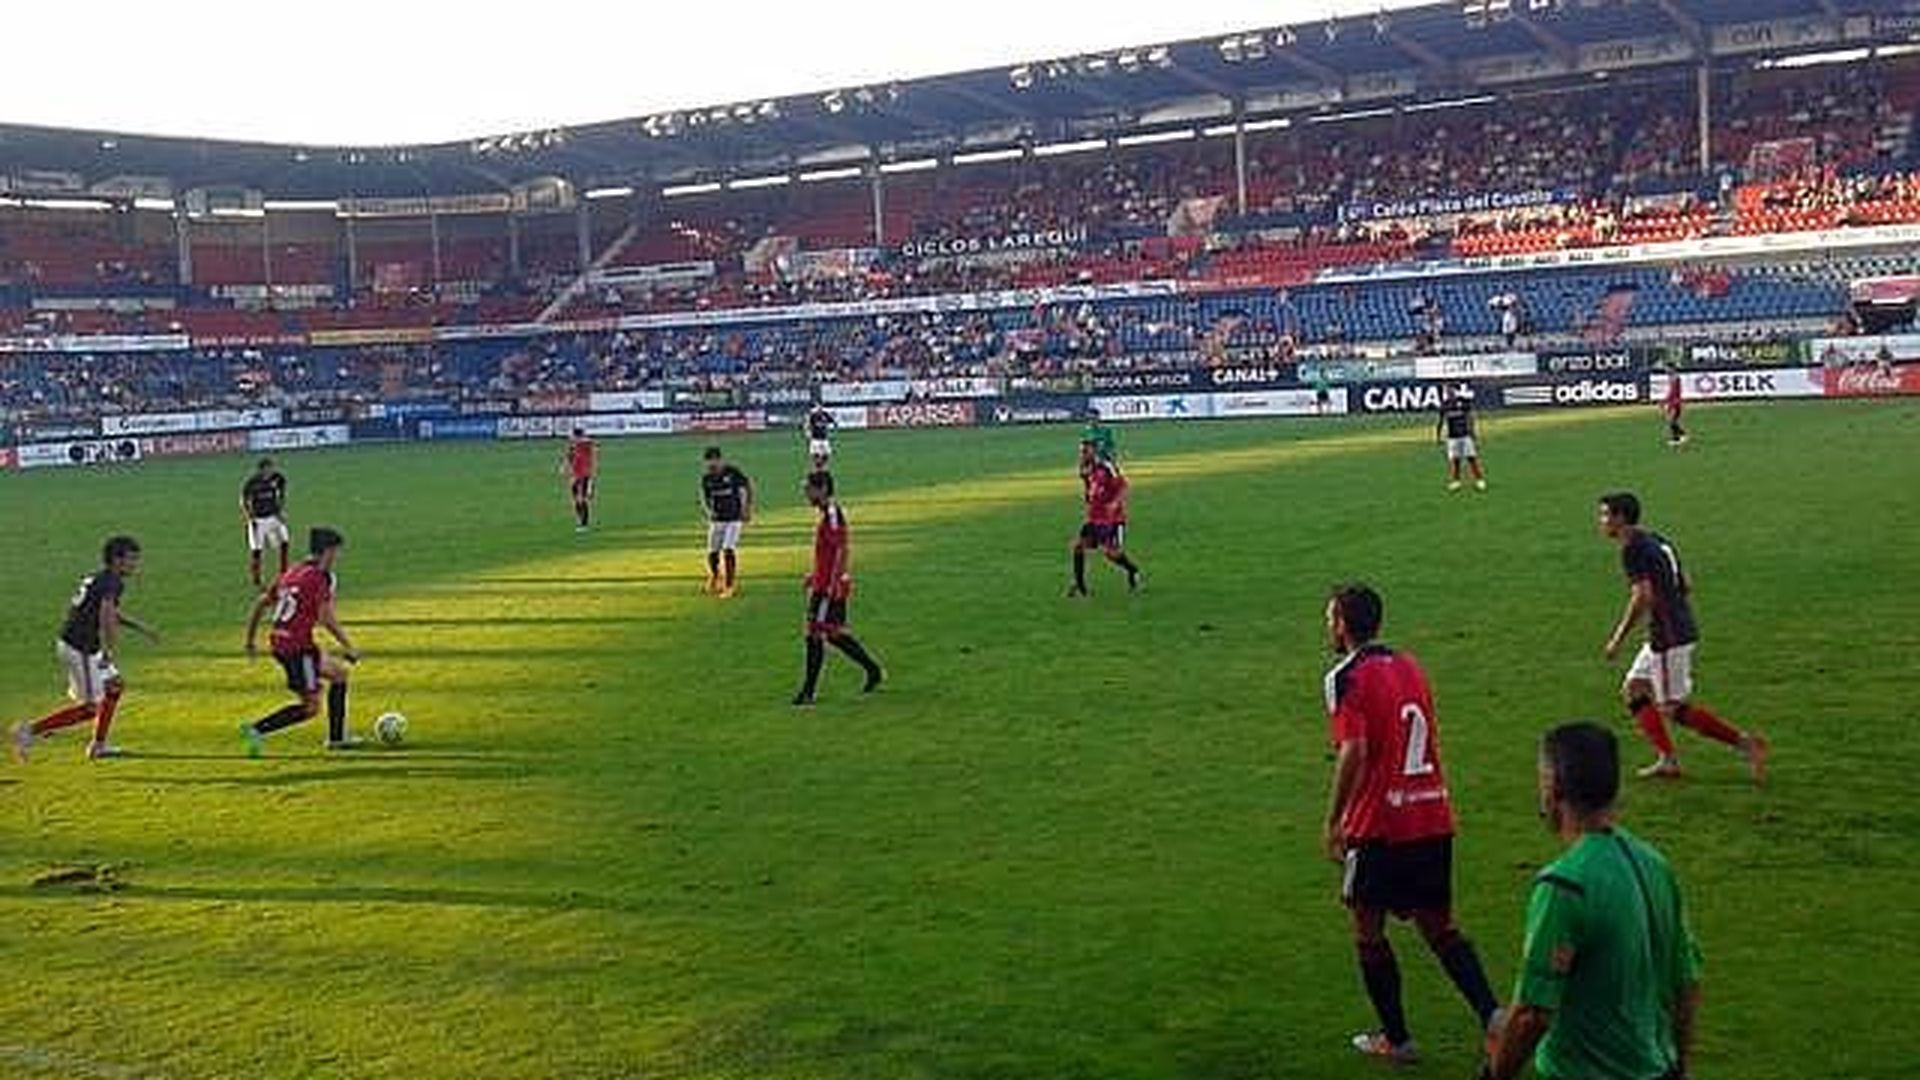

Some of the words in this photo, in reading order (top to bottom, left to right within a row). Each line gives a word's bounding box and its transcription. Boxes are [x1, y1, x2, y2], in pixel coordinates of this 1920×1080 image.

[1464, 193, 1489, 208] del
[902, 238, 981, 257] CICLOS
[1555, 381, 1638, 402] adidas
[1717, 374, 1776, 392] SELK
[1401, 702, 1434, 775] 2
